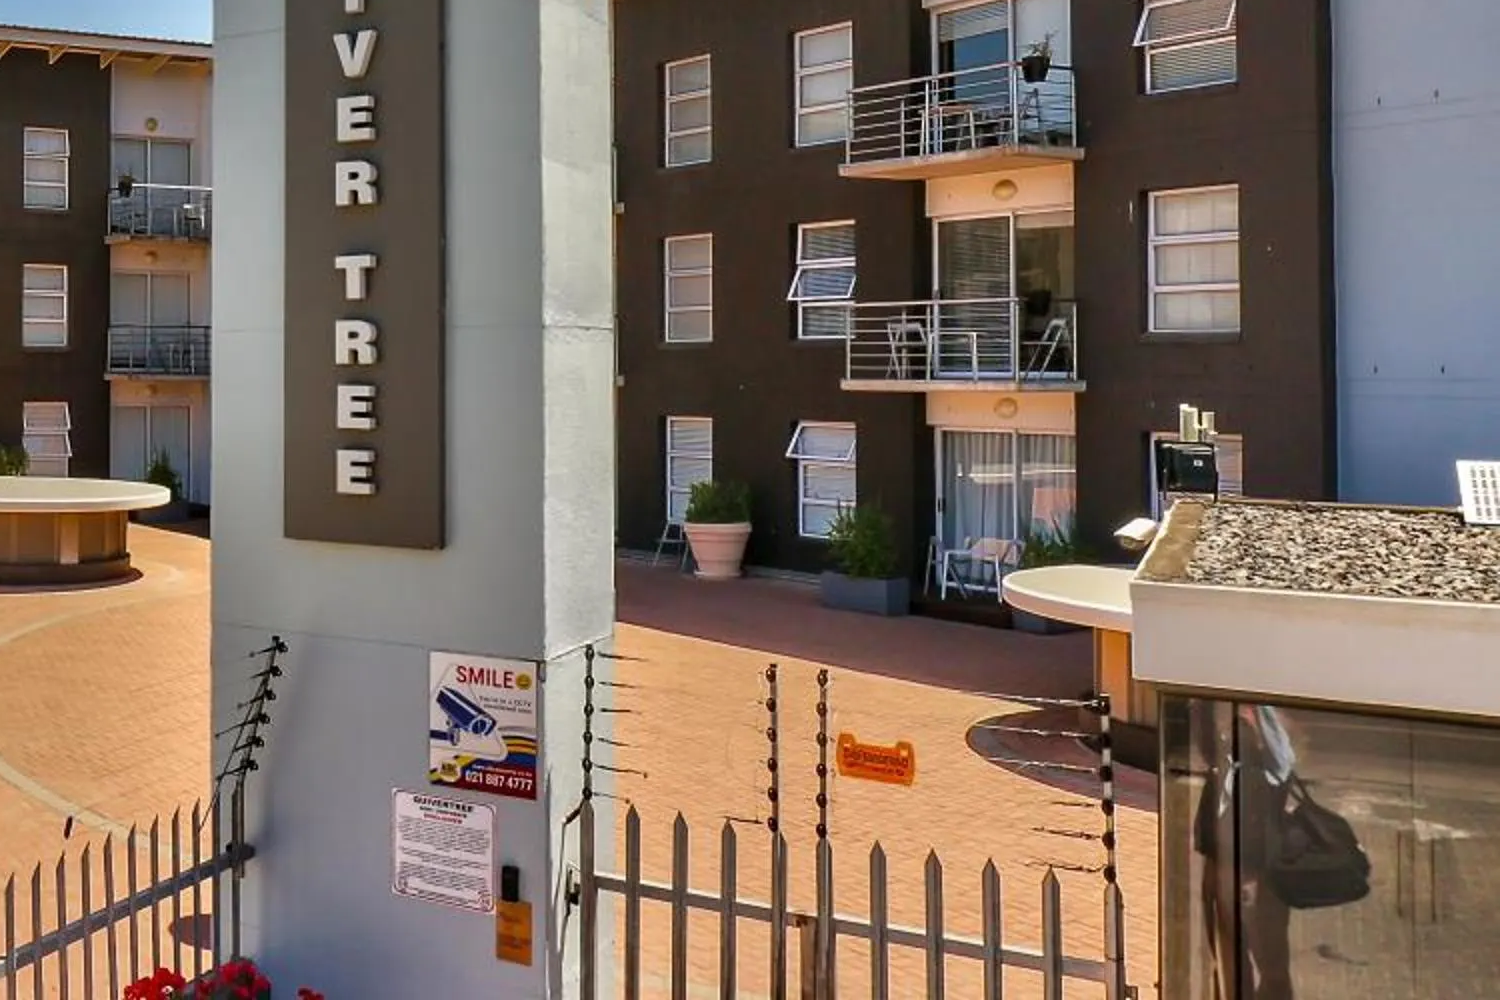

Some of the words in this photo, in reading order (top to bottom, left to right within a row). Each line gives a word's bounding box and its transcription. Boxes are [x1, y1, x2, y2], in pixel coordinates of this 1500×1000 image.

[334, 253, 378, 495] TREE
[456, 665, 514, 689] SMILE
[465, 770, 483, 784] 021
[506, 775, 533, 791] 4777
